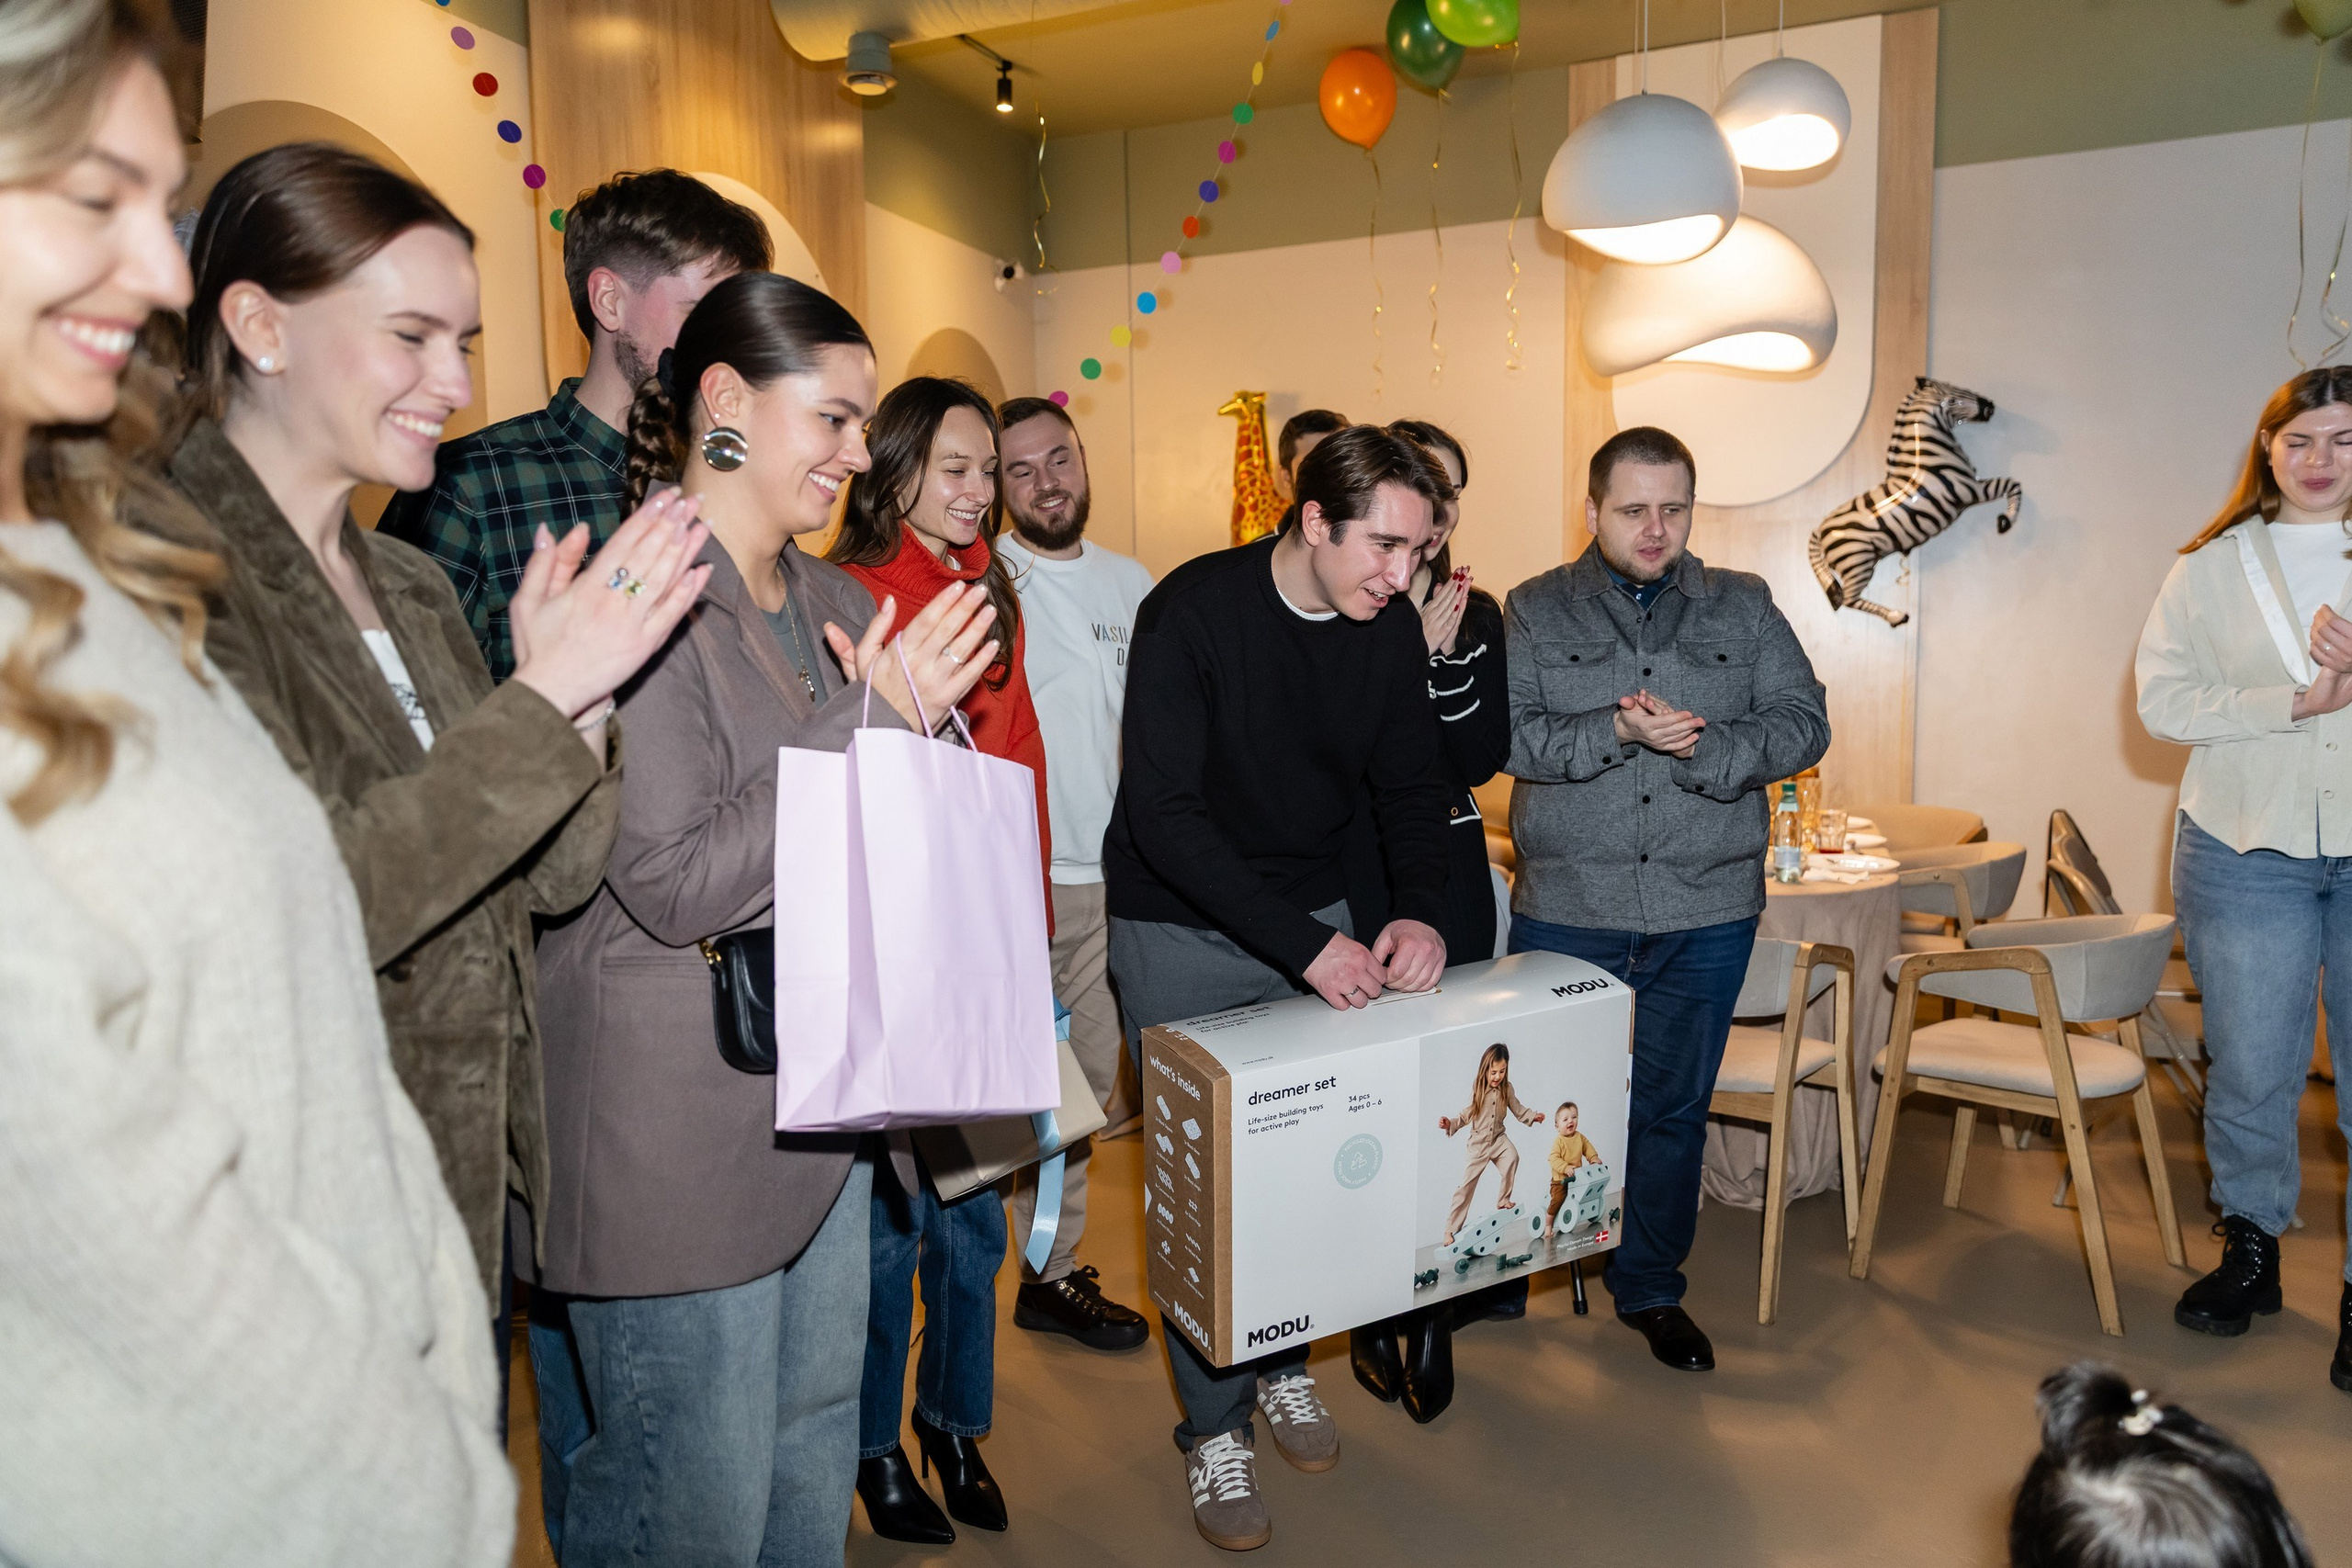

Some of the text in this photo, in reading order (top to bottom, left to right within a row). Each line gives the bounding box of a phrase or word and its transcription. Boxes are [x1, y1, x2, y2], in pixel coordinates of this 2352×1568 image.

[1091, 623, 1130, 644] VASIL
[1117, 648, 1129, 667] D
[1550, 978, 1609, 998] MODU
[1186, 1011, 1245, 1026] dreamer
[1149, 1055, 1201, 1101] what's inside
[1248, 1076, 1337, 1106] dreamer set
[1358, 1093, 1371, 1102] pcs
[1248, 1103, 1324, 1126] Life-size building toys
[1348, 1103, 1365, 1113] Ages
[1248, 1118, 1300, 1135] for active play
[1174, 1300, 1209, 1348] MODU
[1248, 1314, 1309, 1348] MODU
